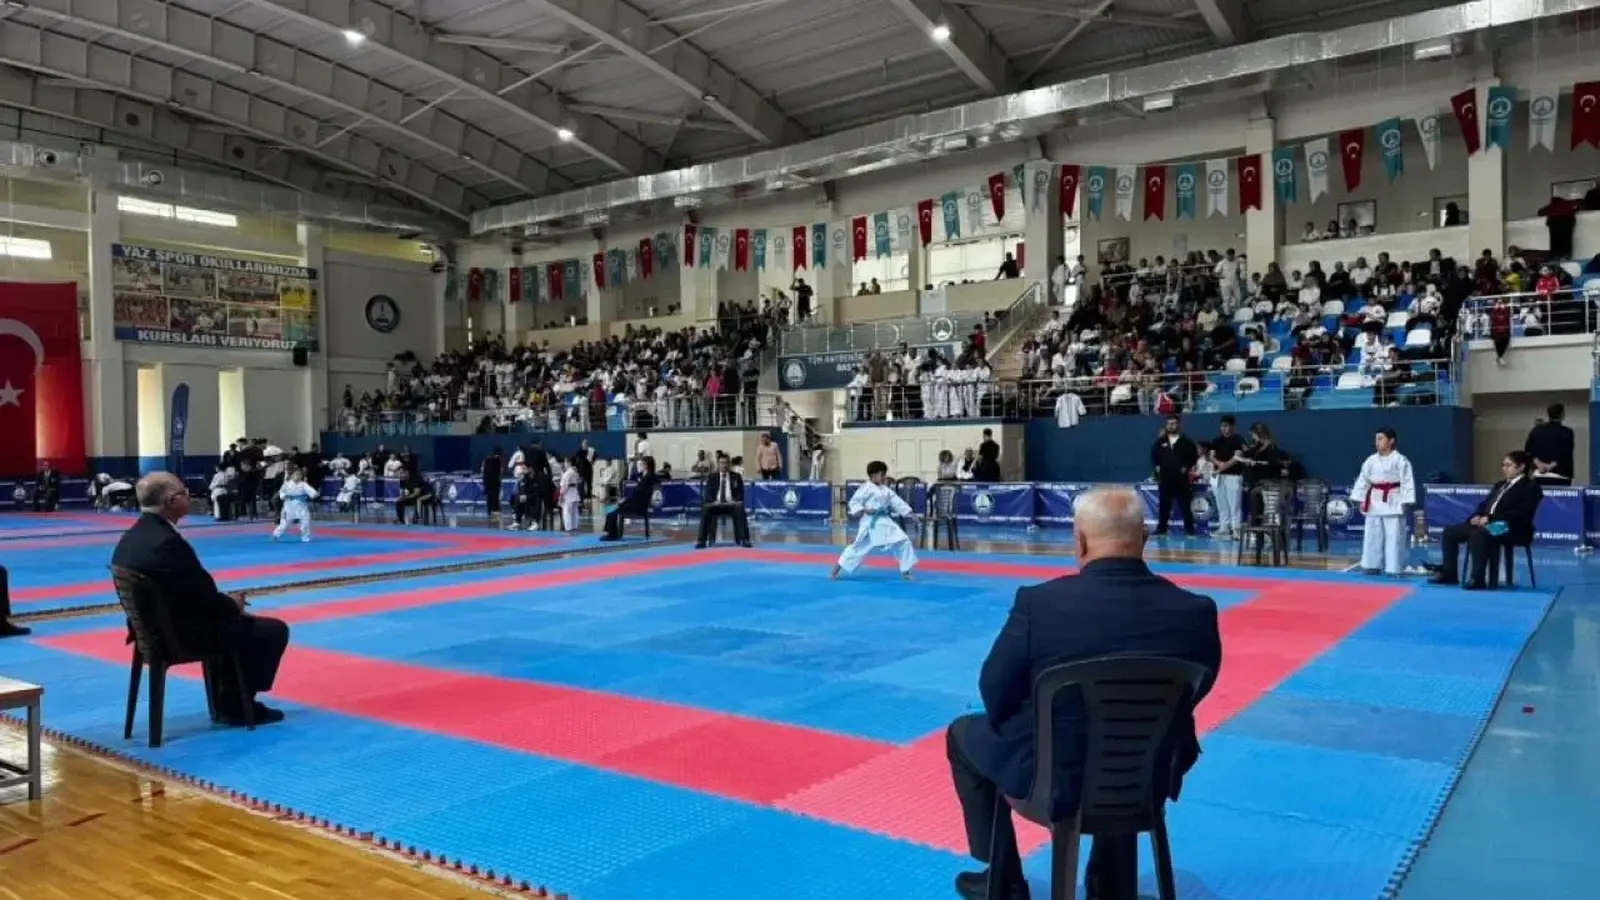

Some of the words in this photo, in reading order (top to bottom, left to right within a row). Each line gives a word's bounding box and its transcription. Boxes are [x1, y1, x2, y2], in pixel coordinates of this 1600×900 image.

[122, 246, 150, 258] YAZ
[155, 249, 196, 265] SPOR
[138, 330, 217, 345] KURSLARI
